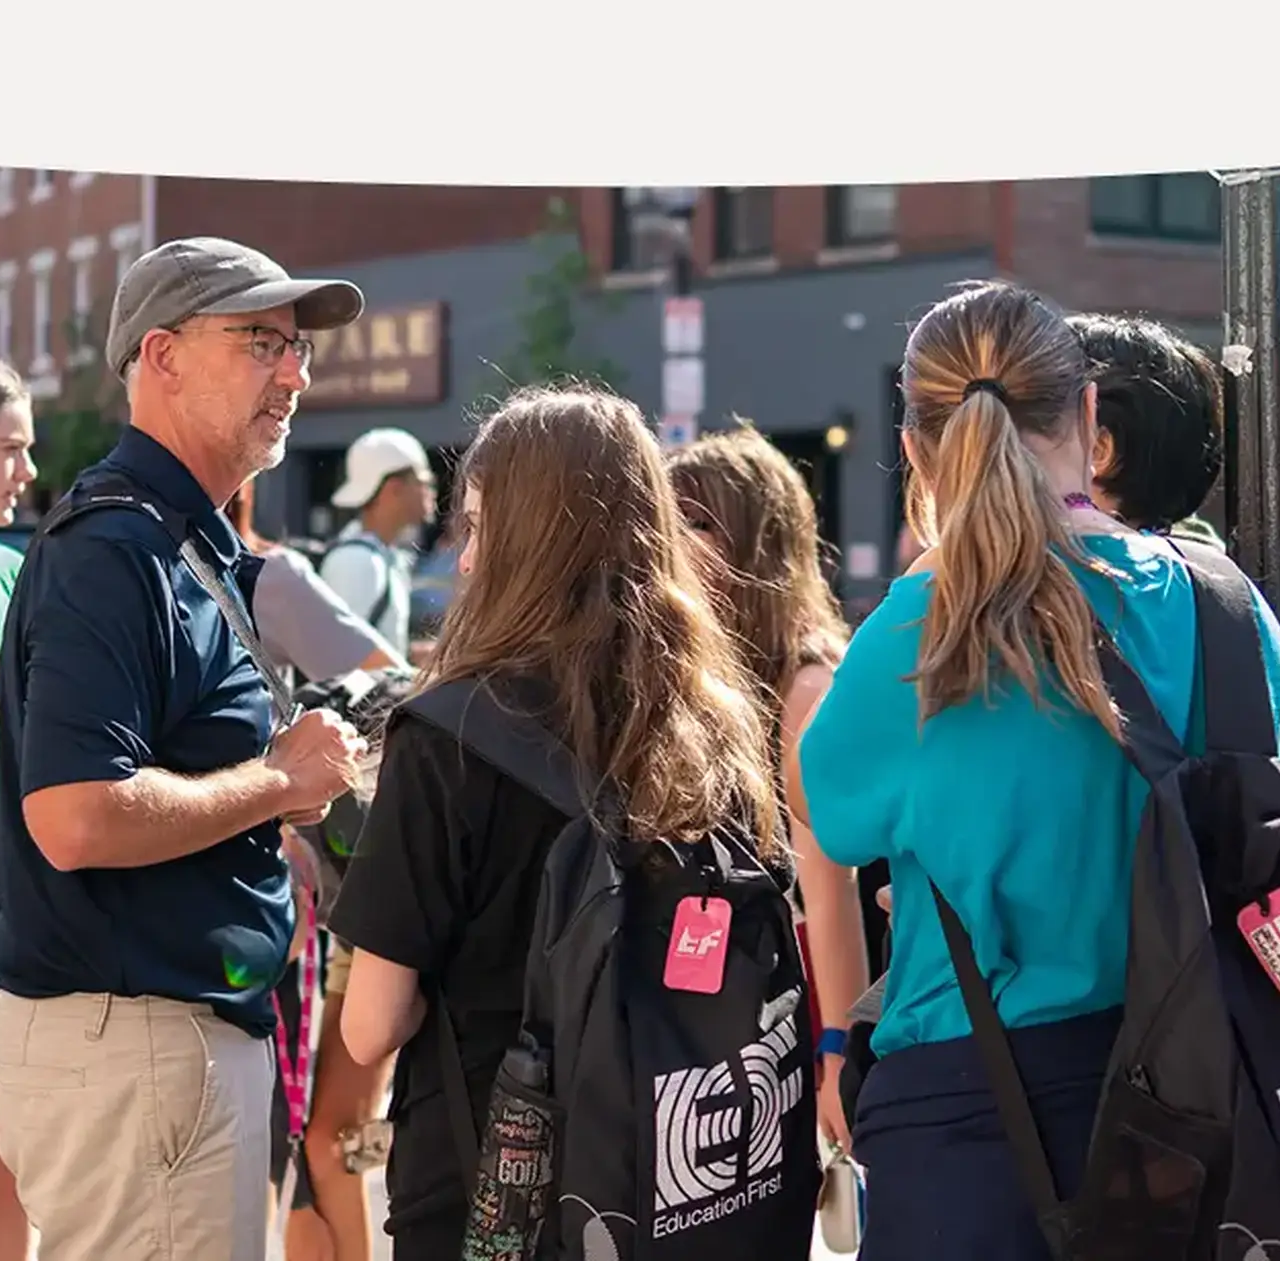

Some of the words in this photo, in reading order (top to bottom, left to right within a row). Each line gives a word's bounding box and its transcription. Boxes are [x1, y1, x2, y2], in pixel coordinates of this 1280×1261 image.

[677, 926, 723, 956] EF
[654, 1014, 803, 1212] EF
[653, 1192, 746, 1239] Education
[747, 1171, 782, 1204] First
